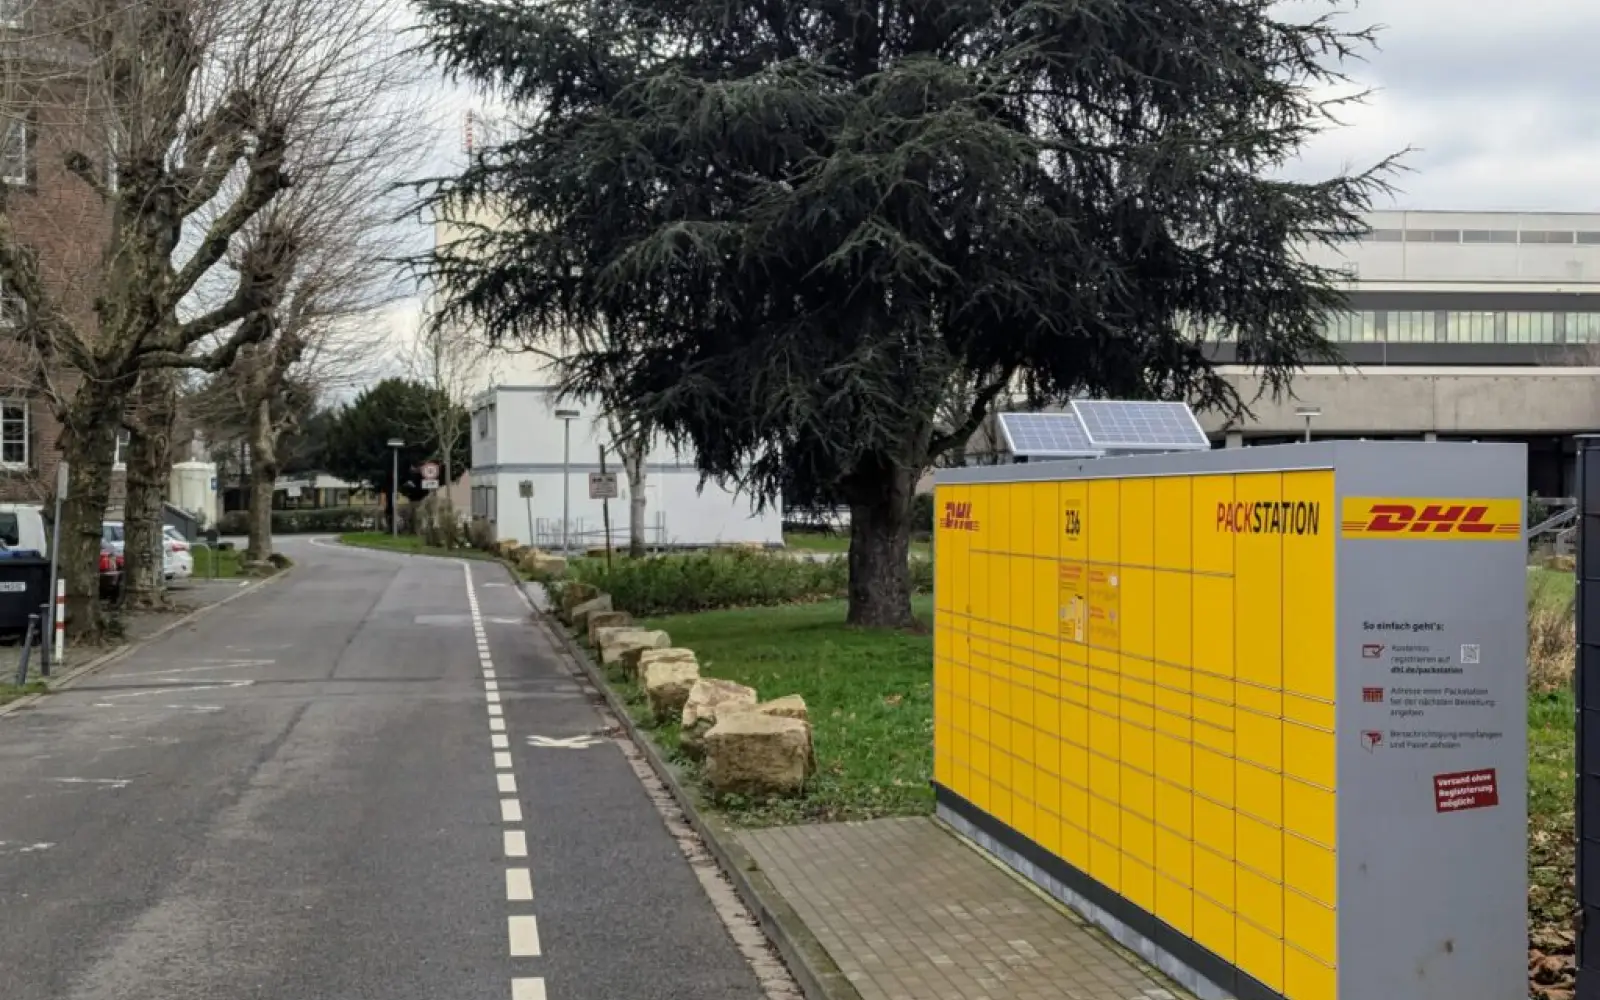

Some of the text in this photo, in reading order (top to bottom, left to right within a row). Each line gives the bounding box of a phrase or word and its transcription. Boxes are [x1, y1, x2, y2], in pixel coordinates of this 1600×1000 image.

[1065, 510, 1080, 535] 236
[1216, 501, 1320, 536] PACKSTATION
[1367, 504, 1496, 533] DHL
[1363, 621, 1445, 632] So einfach geht's:
[1391, 655, 1451, 664] registrieren auf
[1390, 666, 1464, 675] dhl.de/packstation
[1390, 687, 1421, 695] Adresse
[1443, 687, 1489, 695] Packstation
[1404, 698, 1417, 706] der
[1418, 698, 1454, 706] nächsten
[1390, 709, 1424, 718] angeben
[1458, 729, 1503, 740] empfangen
[1390, 742, 1406, 750] und
[1438, 773, 1492, 786] Versand ohne
[1438, 785, 1493, 798] Registrierung
[1440, 797, 1476, 808] möglich!
